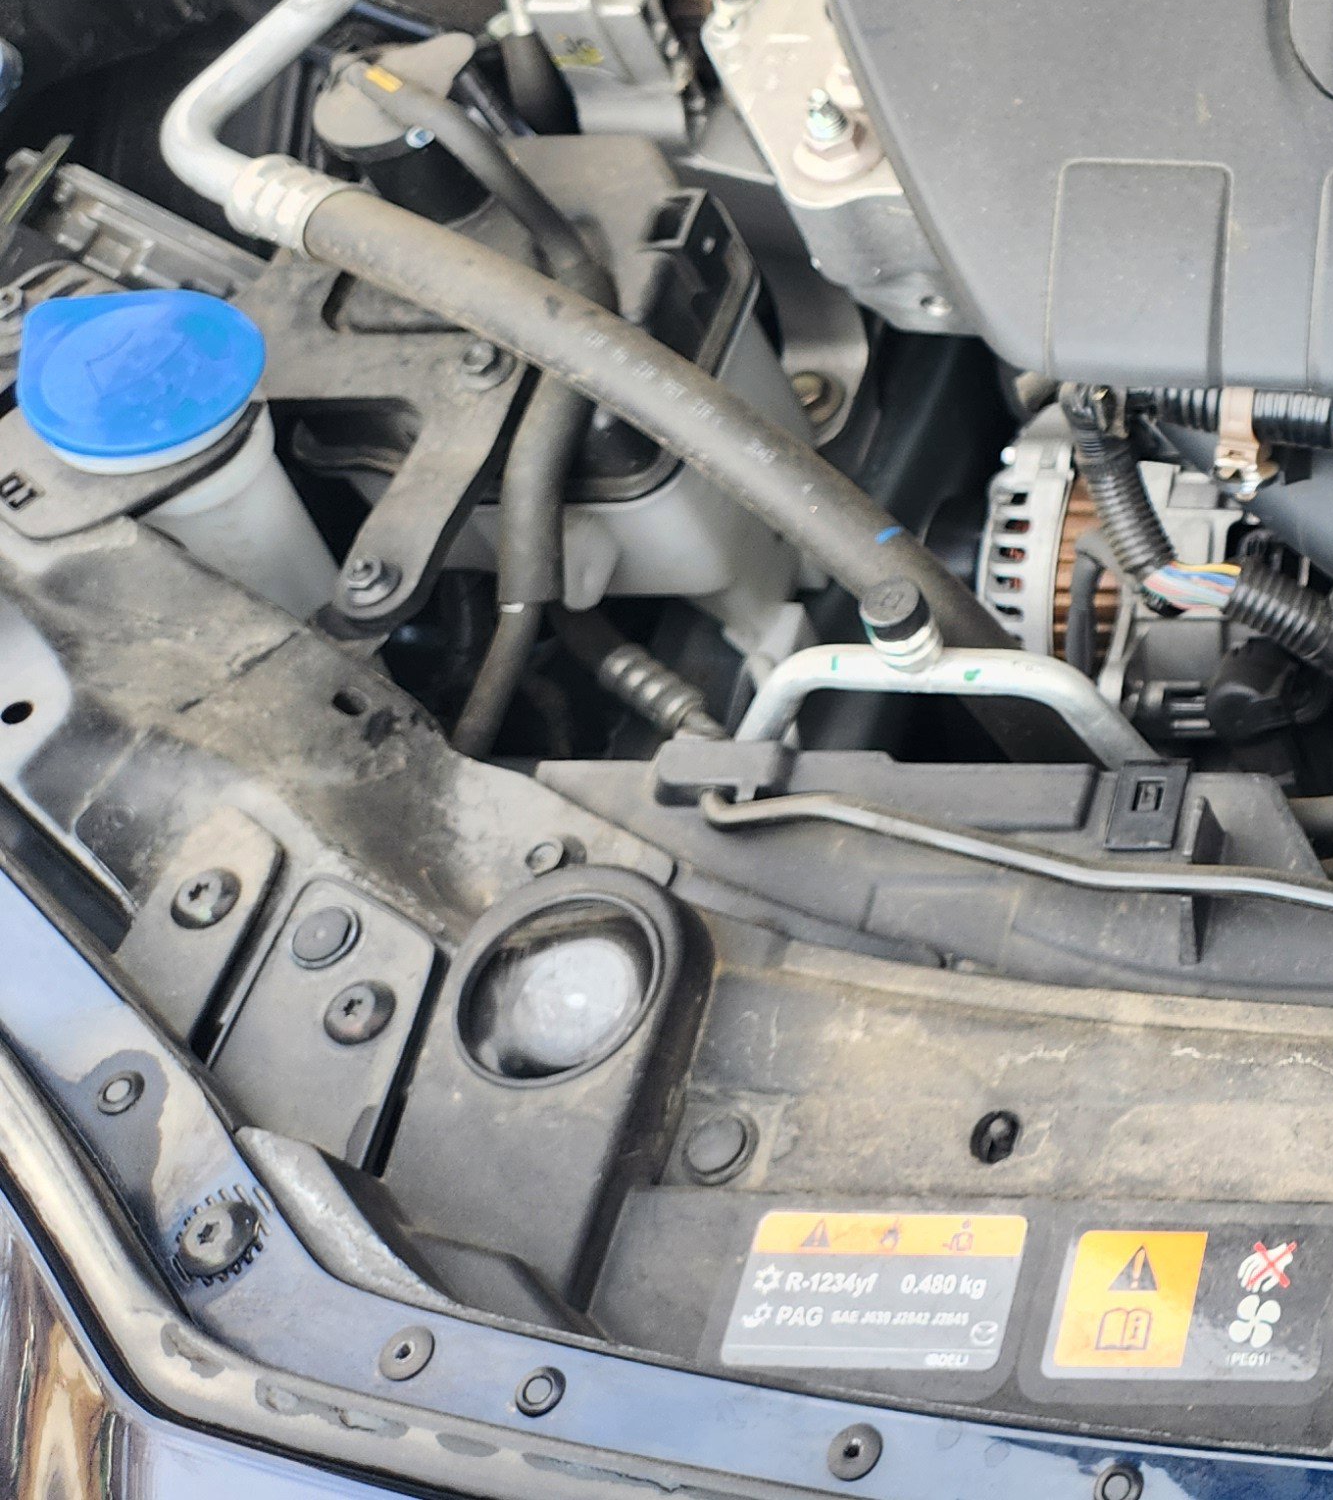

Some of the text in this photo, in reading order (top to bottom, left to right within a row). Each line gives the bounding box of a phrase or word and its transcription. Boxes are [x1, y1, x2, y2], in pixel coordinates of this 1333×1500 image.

[784, 1271, 987, 1299] R-1234yf 0.480 kg
[774, 1305, 824, 1327] PAG
